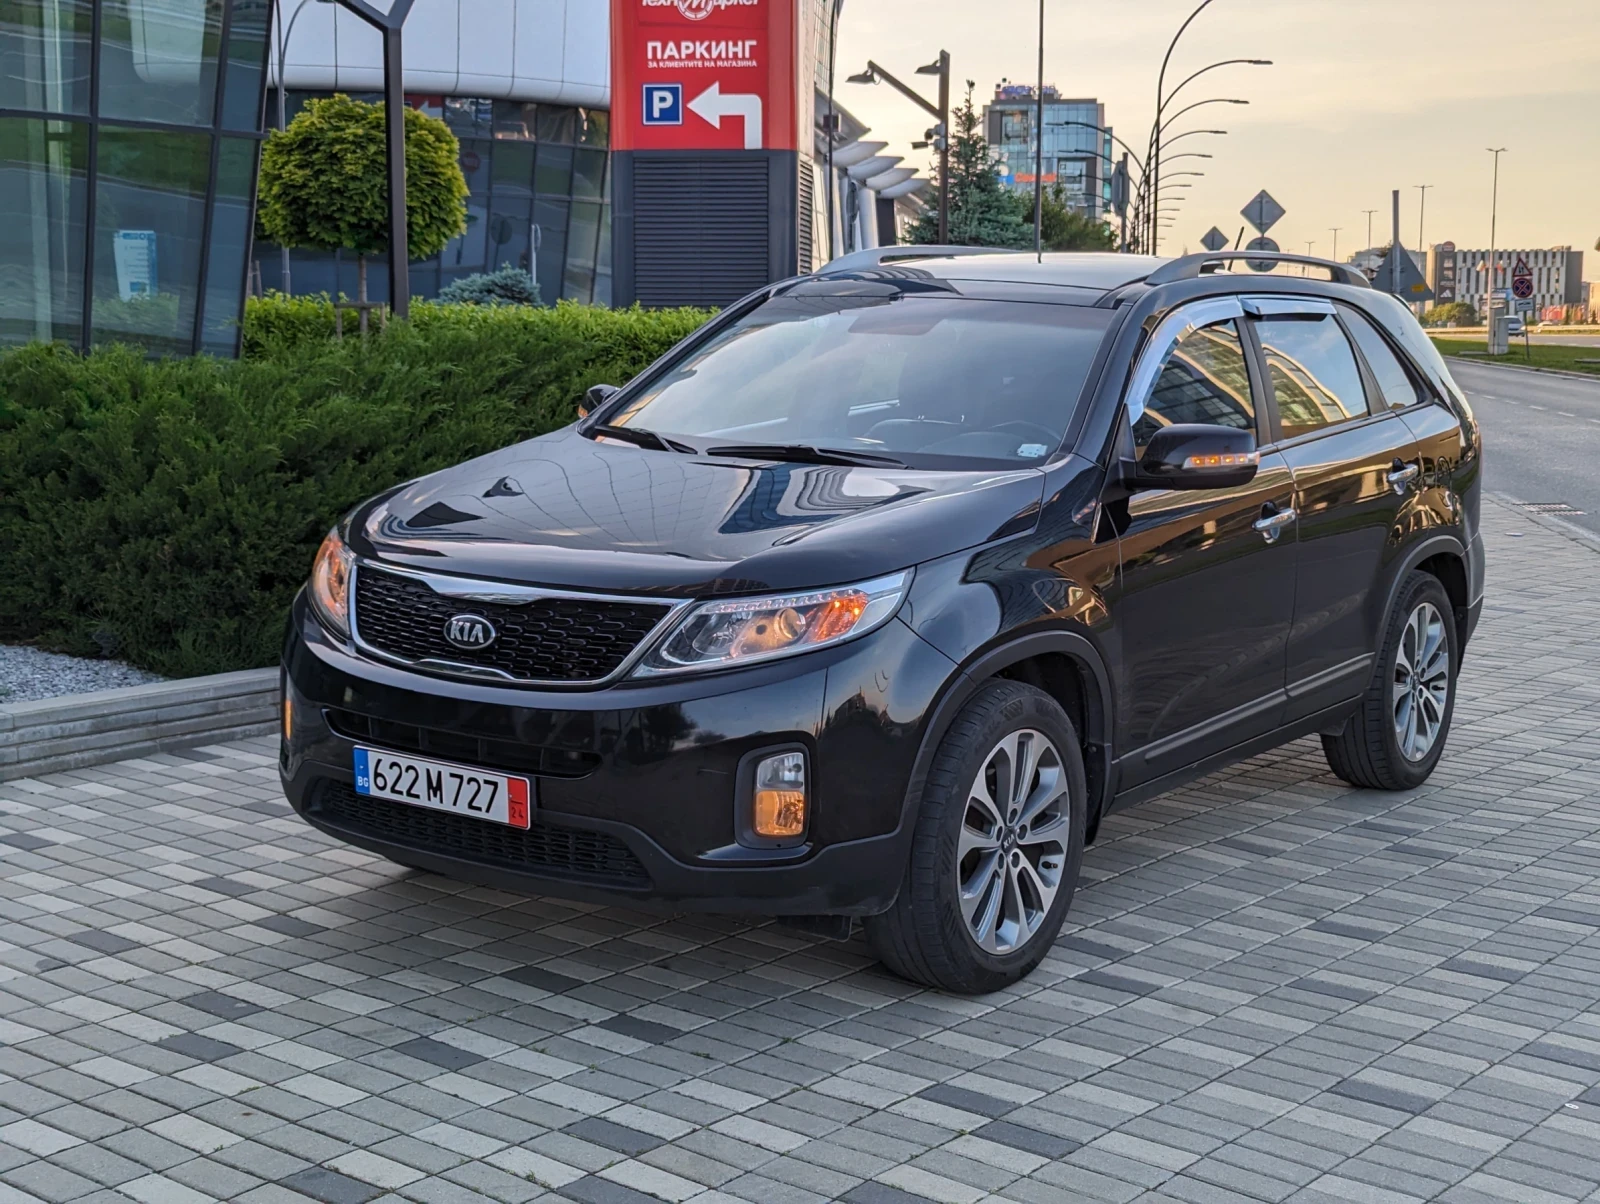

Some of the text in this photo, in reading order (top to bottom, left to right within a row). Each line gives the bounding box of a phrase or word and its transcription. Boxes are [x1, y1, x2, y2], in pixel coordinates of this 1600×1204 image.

[647, 40, 757, 60] ПАРКИНГ
[647, 59, 758, 69] ЗА КЛИЕНТИТЕ НА МАГАЗИНА
[652, 90, 674, 118] P
[450, 620, 485, 643] KIA
[357, 775, 369, 787] BG
